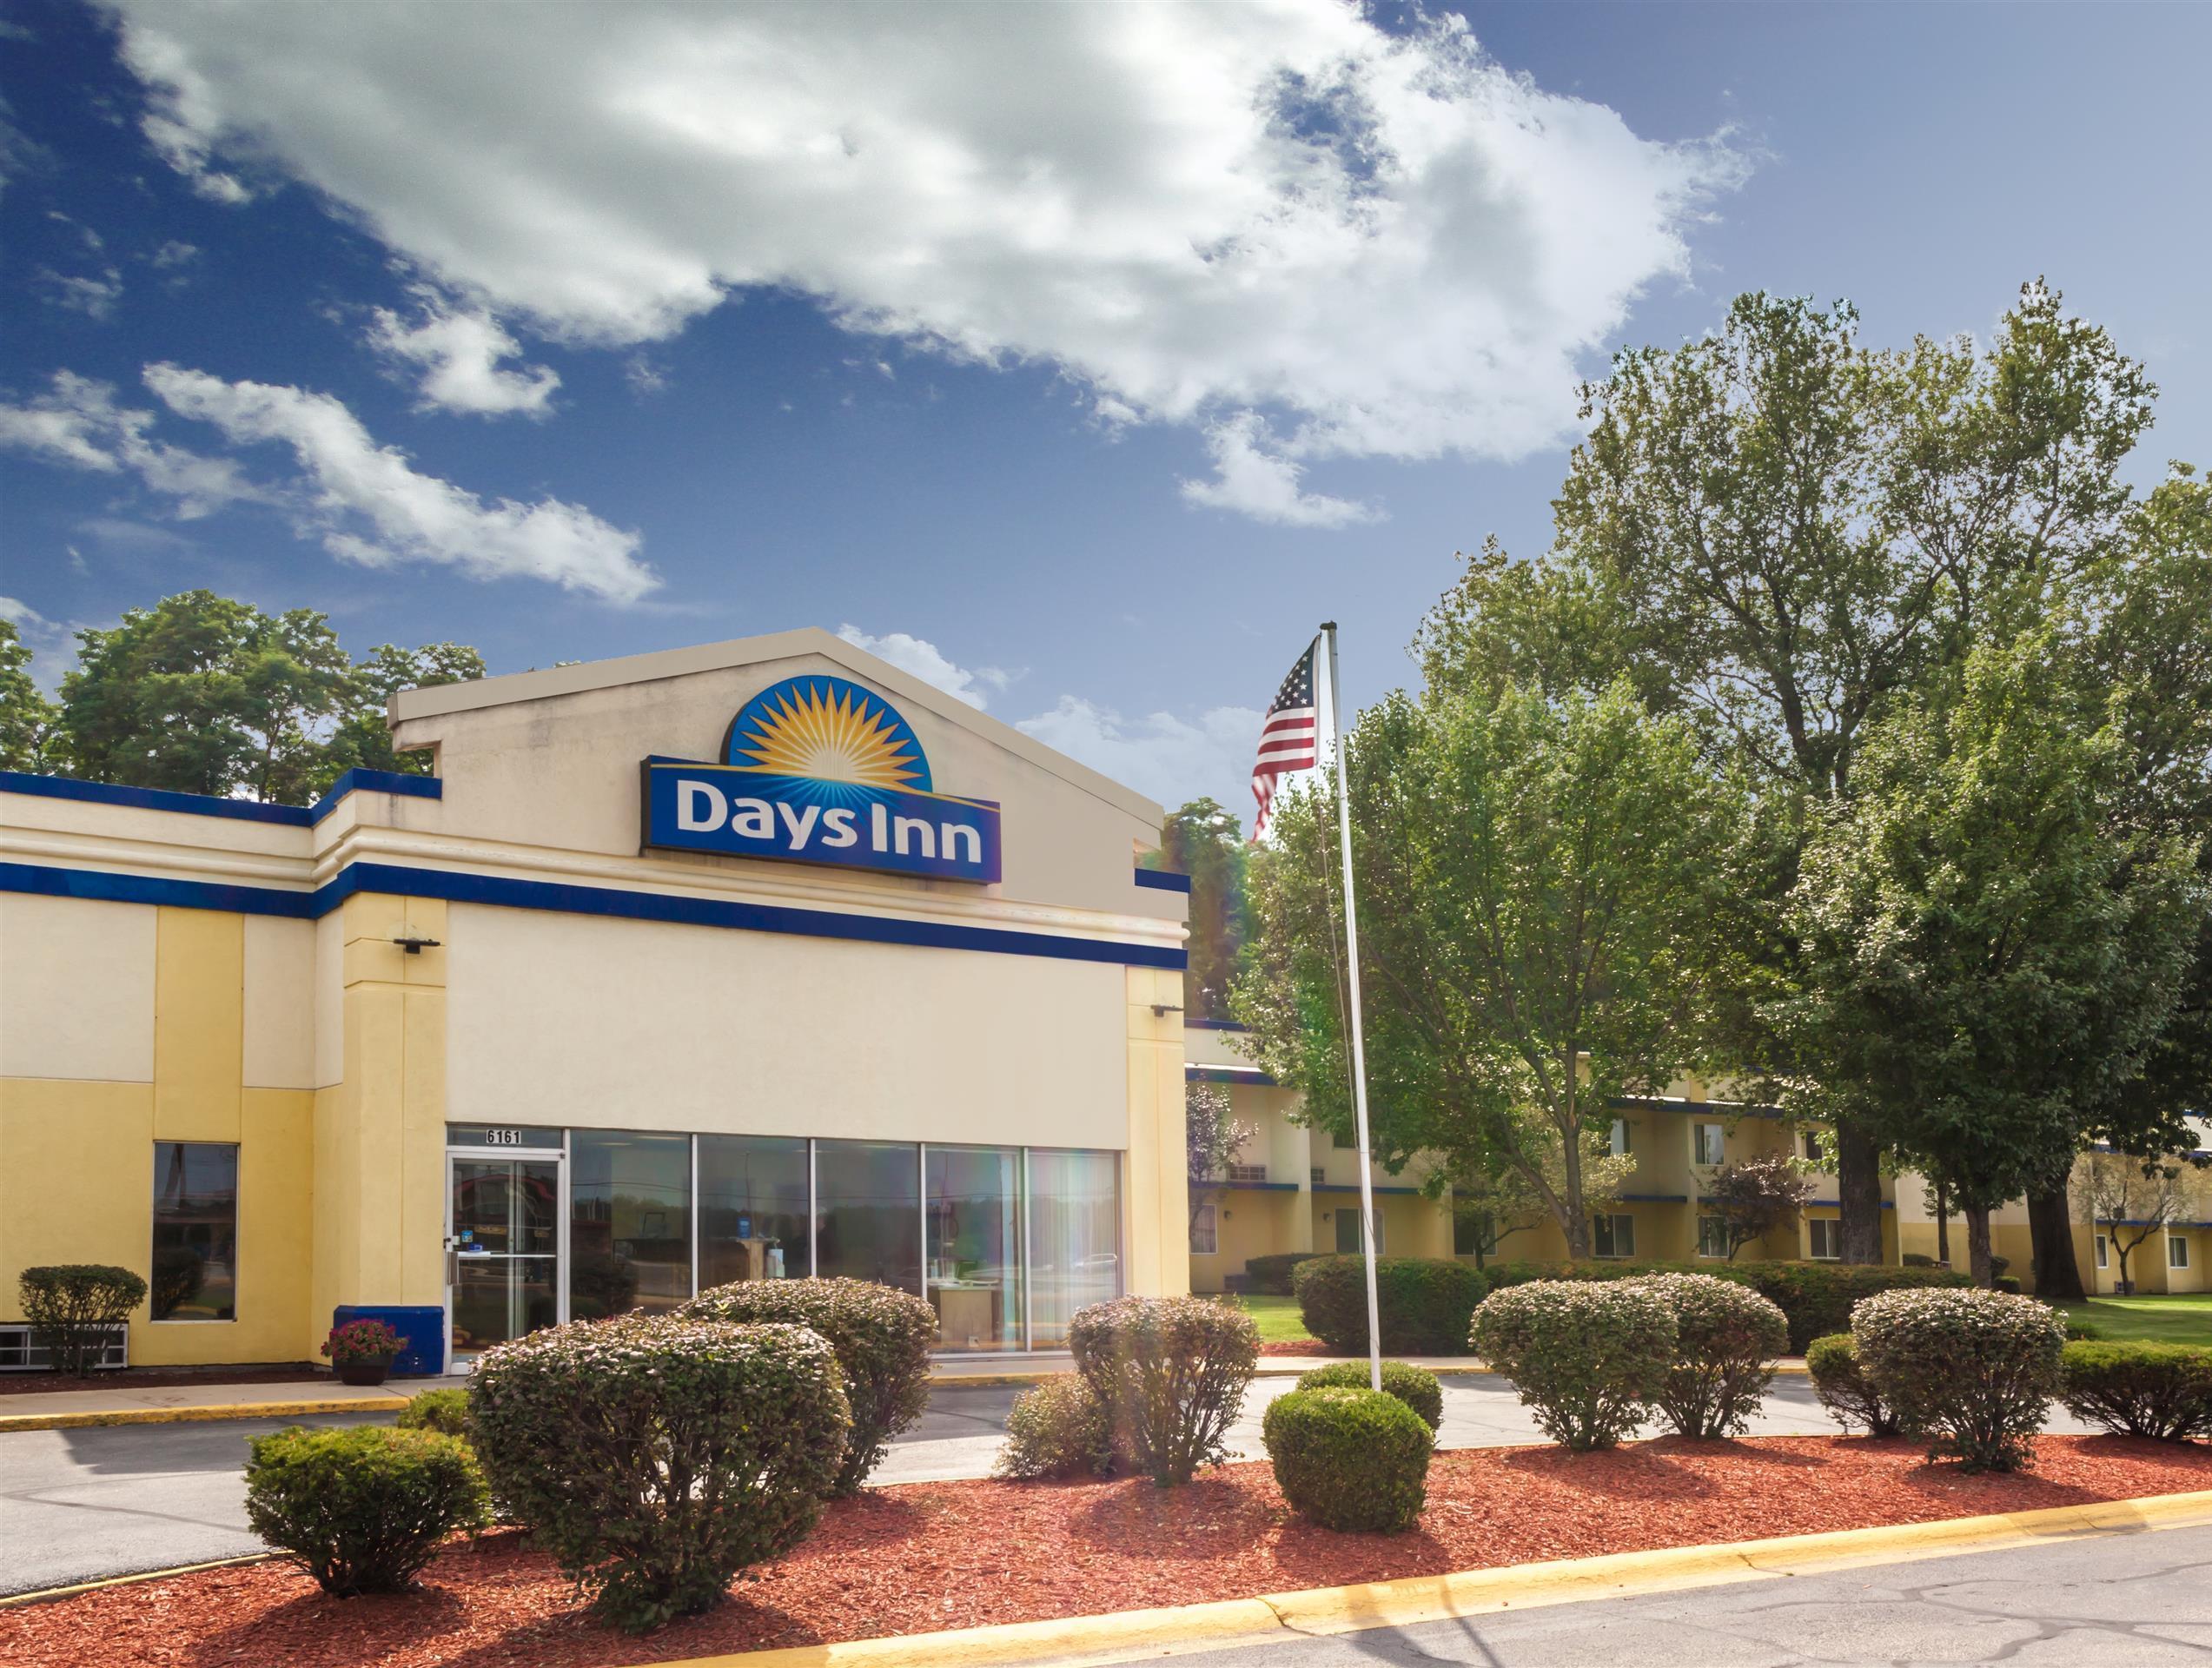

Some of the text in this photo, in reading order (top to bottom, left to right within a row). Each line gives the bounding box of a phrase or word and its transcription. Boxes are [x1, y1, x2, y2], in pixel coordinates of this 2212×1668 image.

[677, 779, 982, 864] Days Inn
[487, 1130, 520, 1143] 6161
